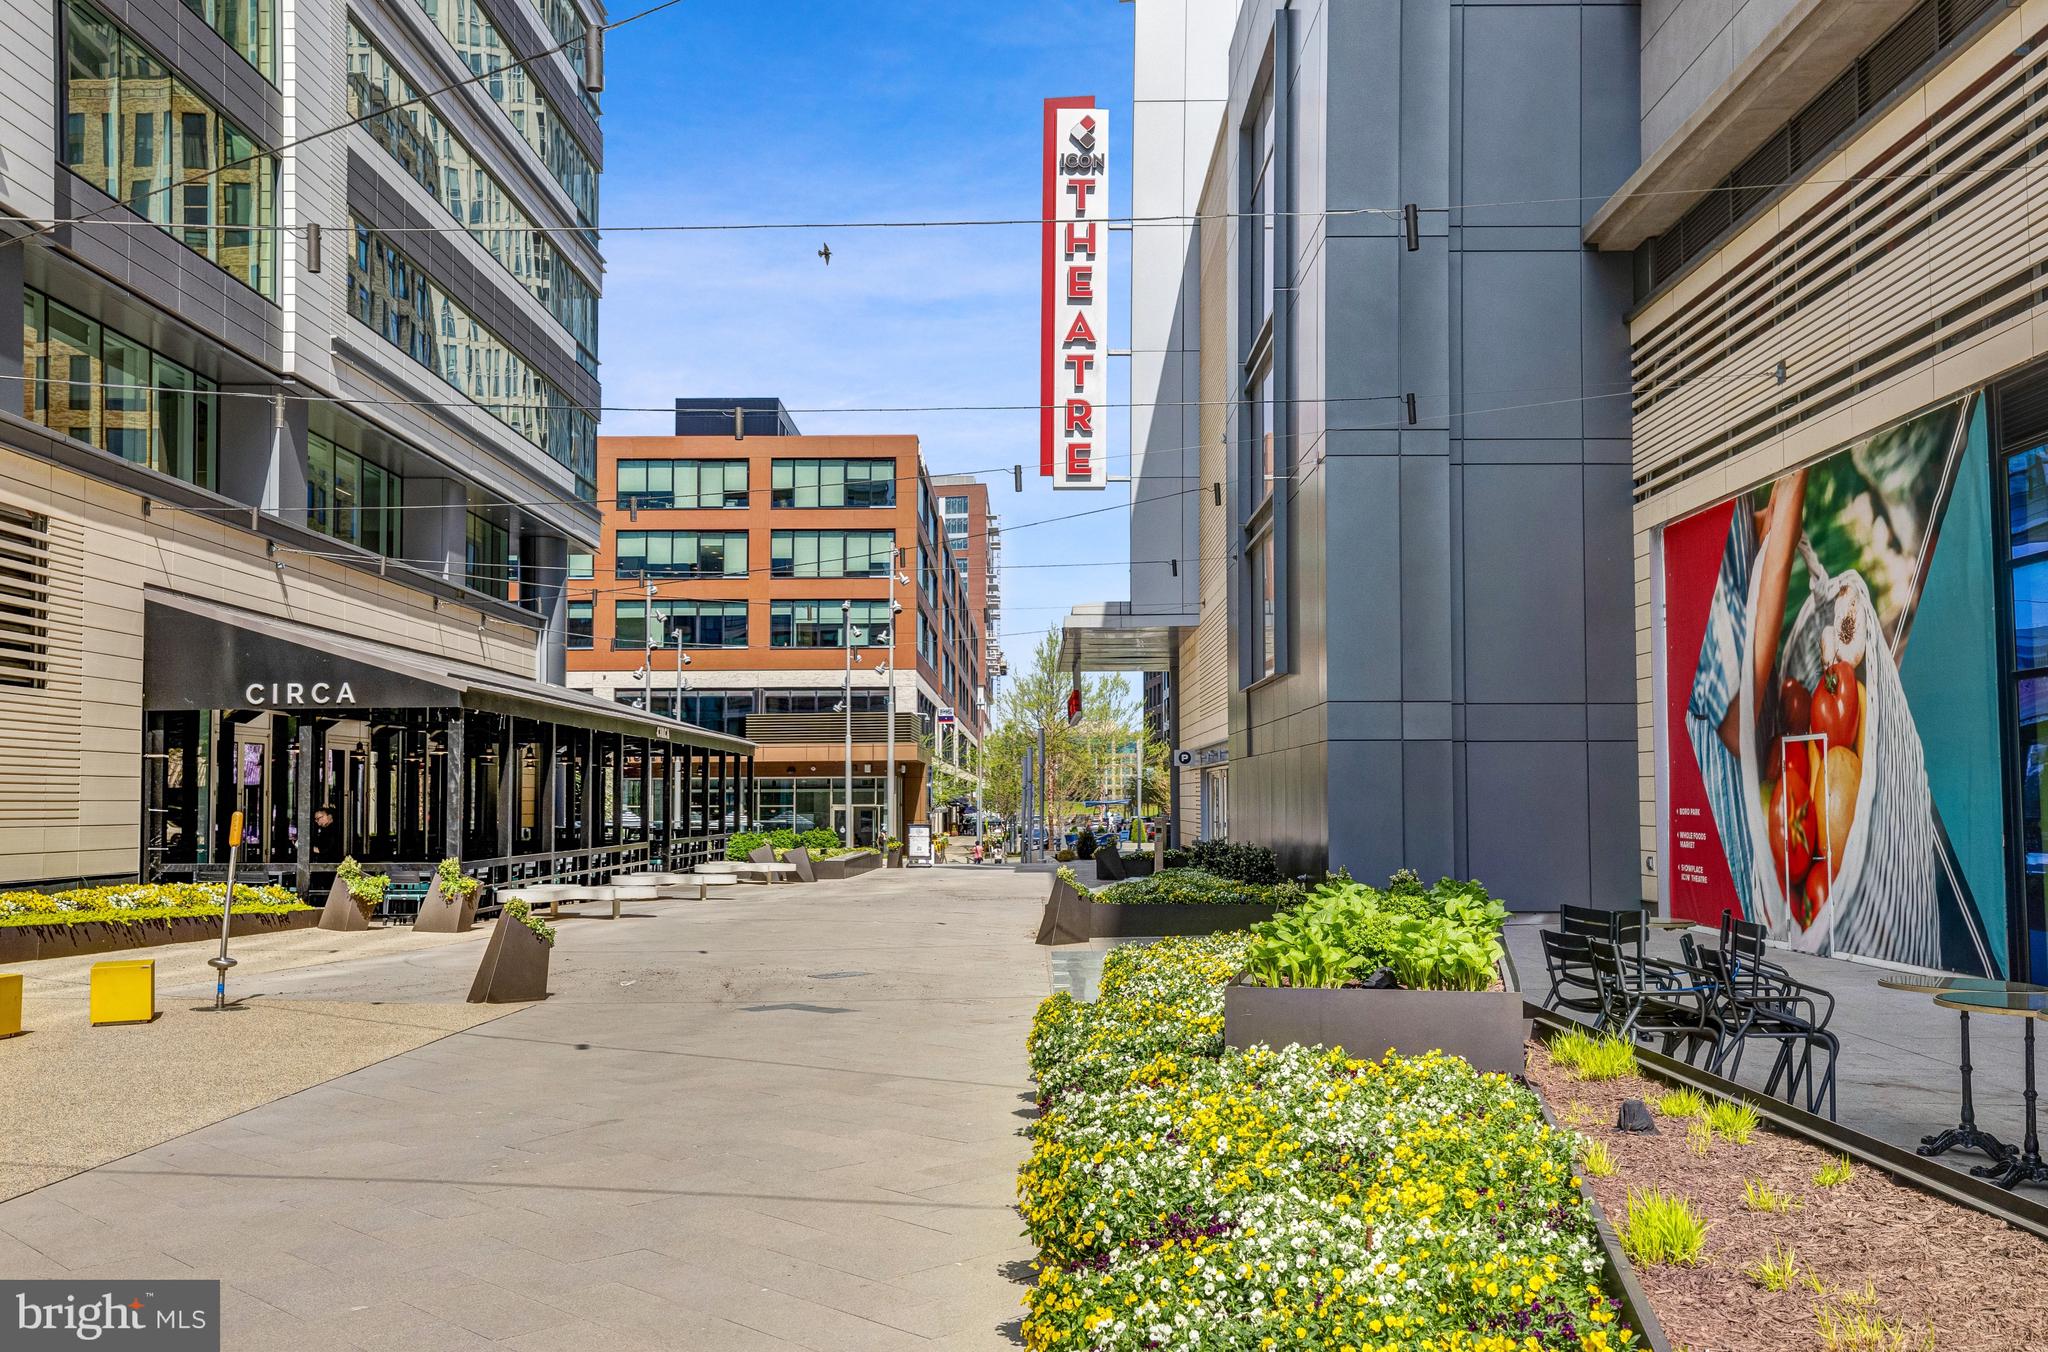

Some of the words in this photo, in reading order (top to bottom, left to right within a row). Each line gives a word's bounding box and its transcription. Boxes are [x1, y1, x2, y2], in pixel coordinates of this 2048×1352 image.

[1060, 153, 1105, 171] ICON
[1064, 179, 1098, 477] THEATRE
[245, 682, 356, 705] CIRCA
[1693, 832, 1706, 840] FOODS
[1691, 874, 1707, 883] THEATRE
